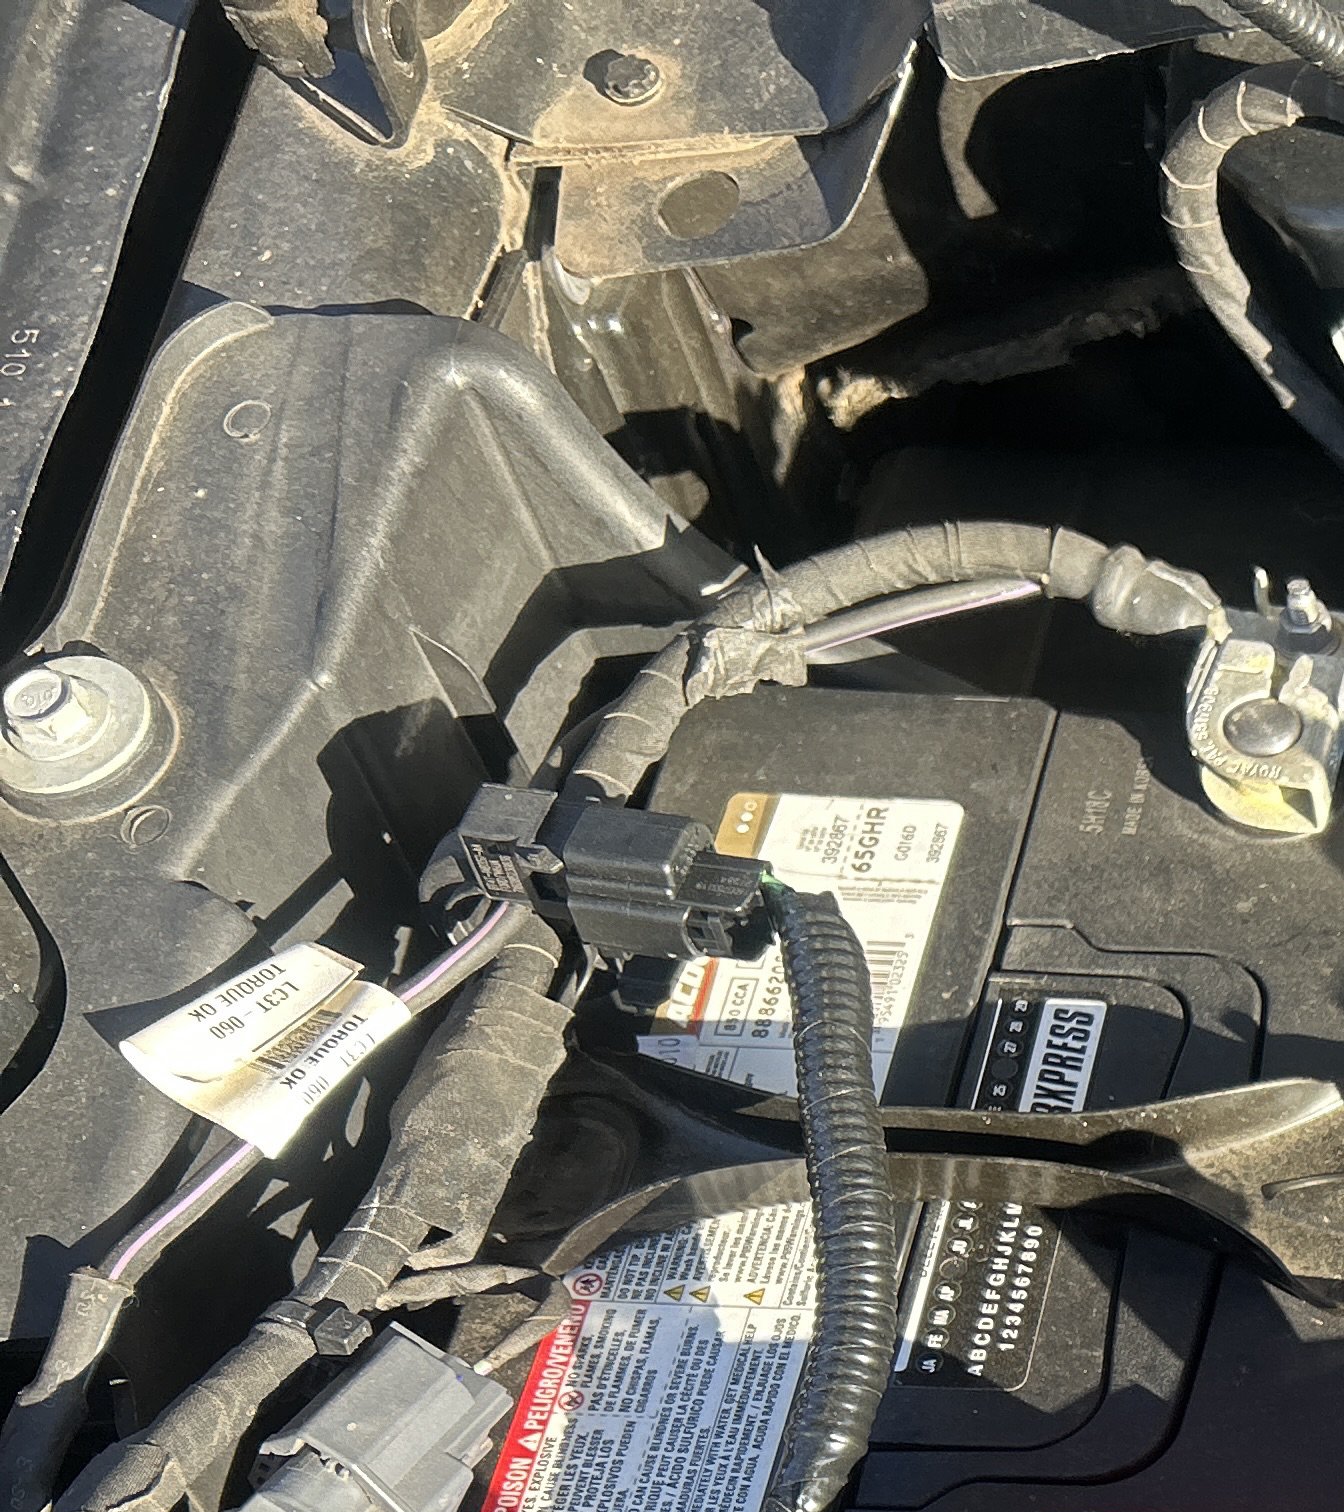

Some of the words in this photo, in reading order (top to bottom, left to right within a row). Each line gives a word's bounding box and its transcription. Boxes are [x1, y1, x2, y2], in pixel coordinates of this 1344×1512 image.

[847, 806, 891, 873] 65GHR
[213, 962, 286, 1009] TORQUE
[729, 981, 750, 1006] CCA
[186, 1001, 217, 1024] OK
[303, 1015, 368, 1068] TORQUE
[279, 1066, 307, 1091] OK
[998, 1224, 1044, 1351] 1234567890
[529, 1437, 555, 1490] EXPLOSIVE
[563, 1463, 577, 1481] LES
